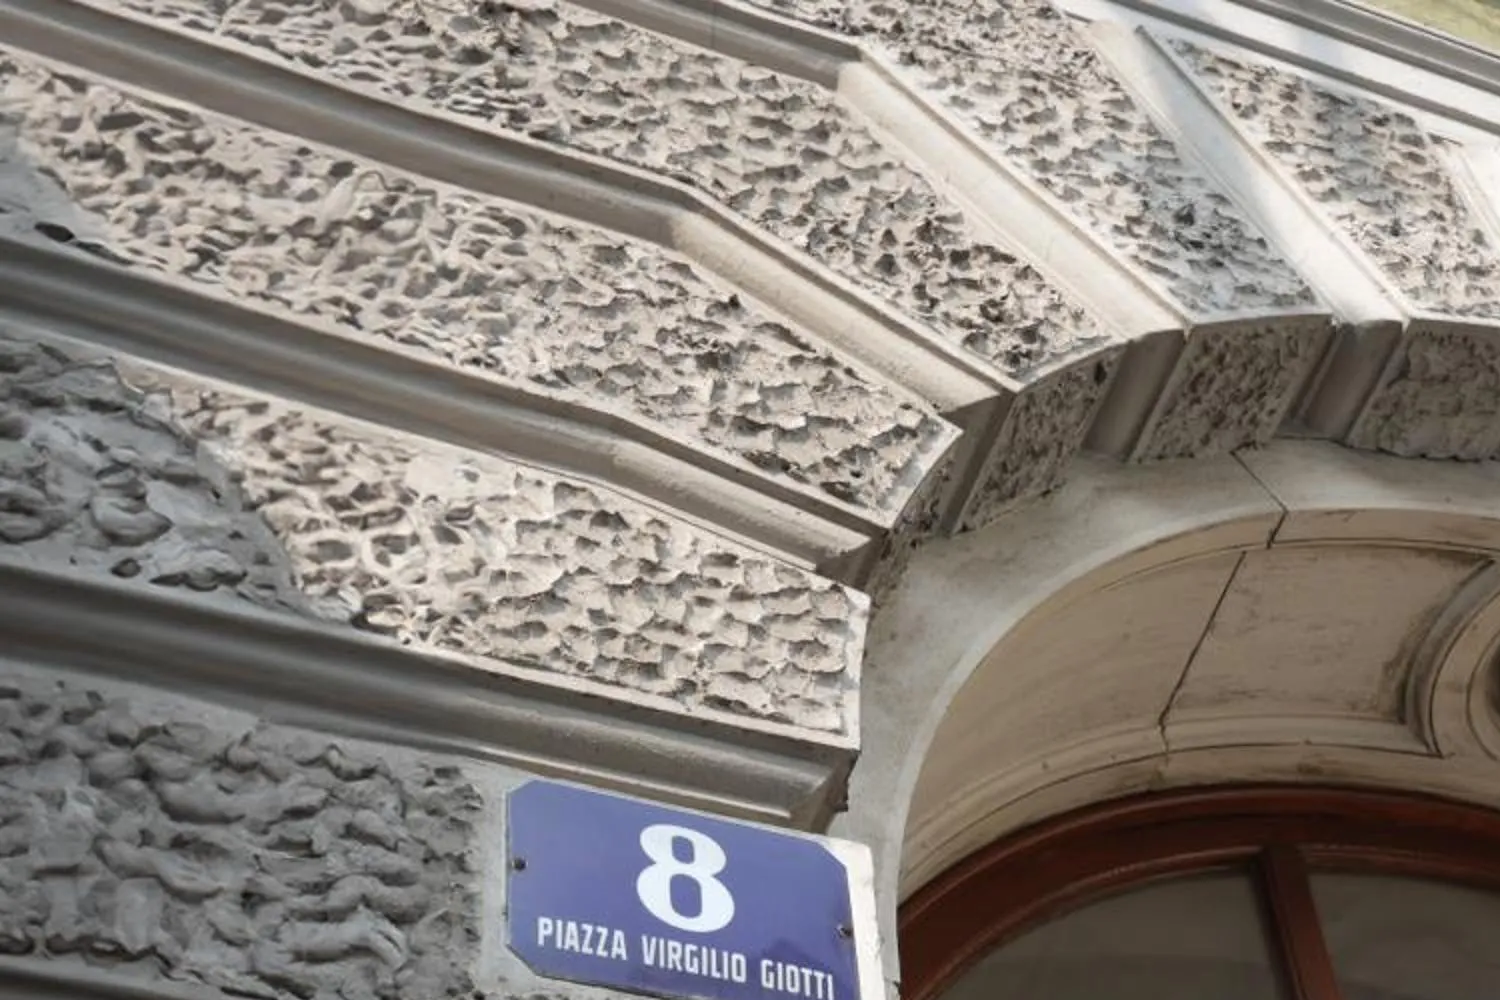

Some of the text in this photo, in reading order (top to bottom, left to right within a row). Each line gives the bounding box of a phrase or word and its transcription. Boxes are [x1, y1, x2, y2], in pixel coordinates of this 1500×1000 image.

[636, 823, 735, 933] 8
[537, 916, 628, 961] PIAZZA
[641, 935, 747, 983] VIRGILIO
